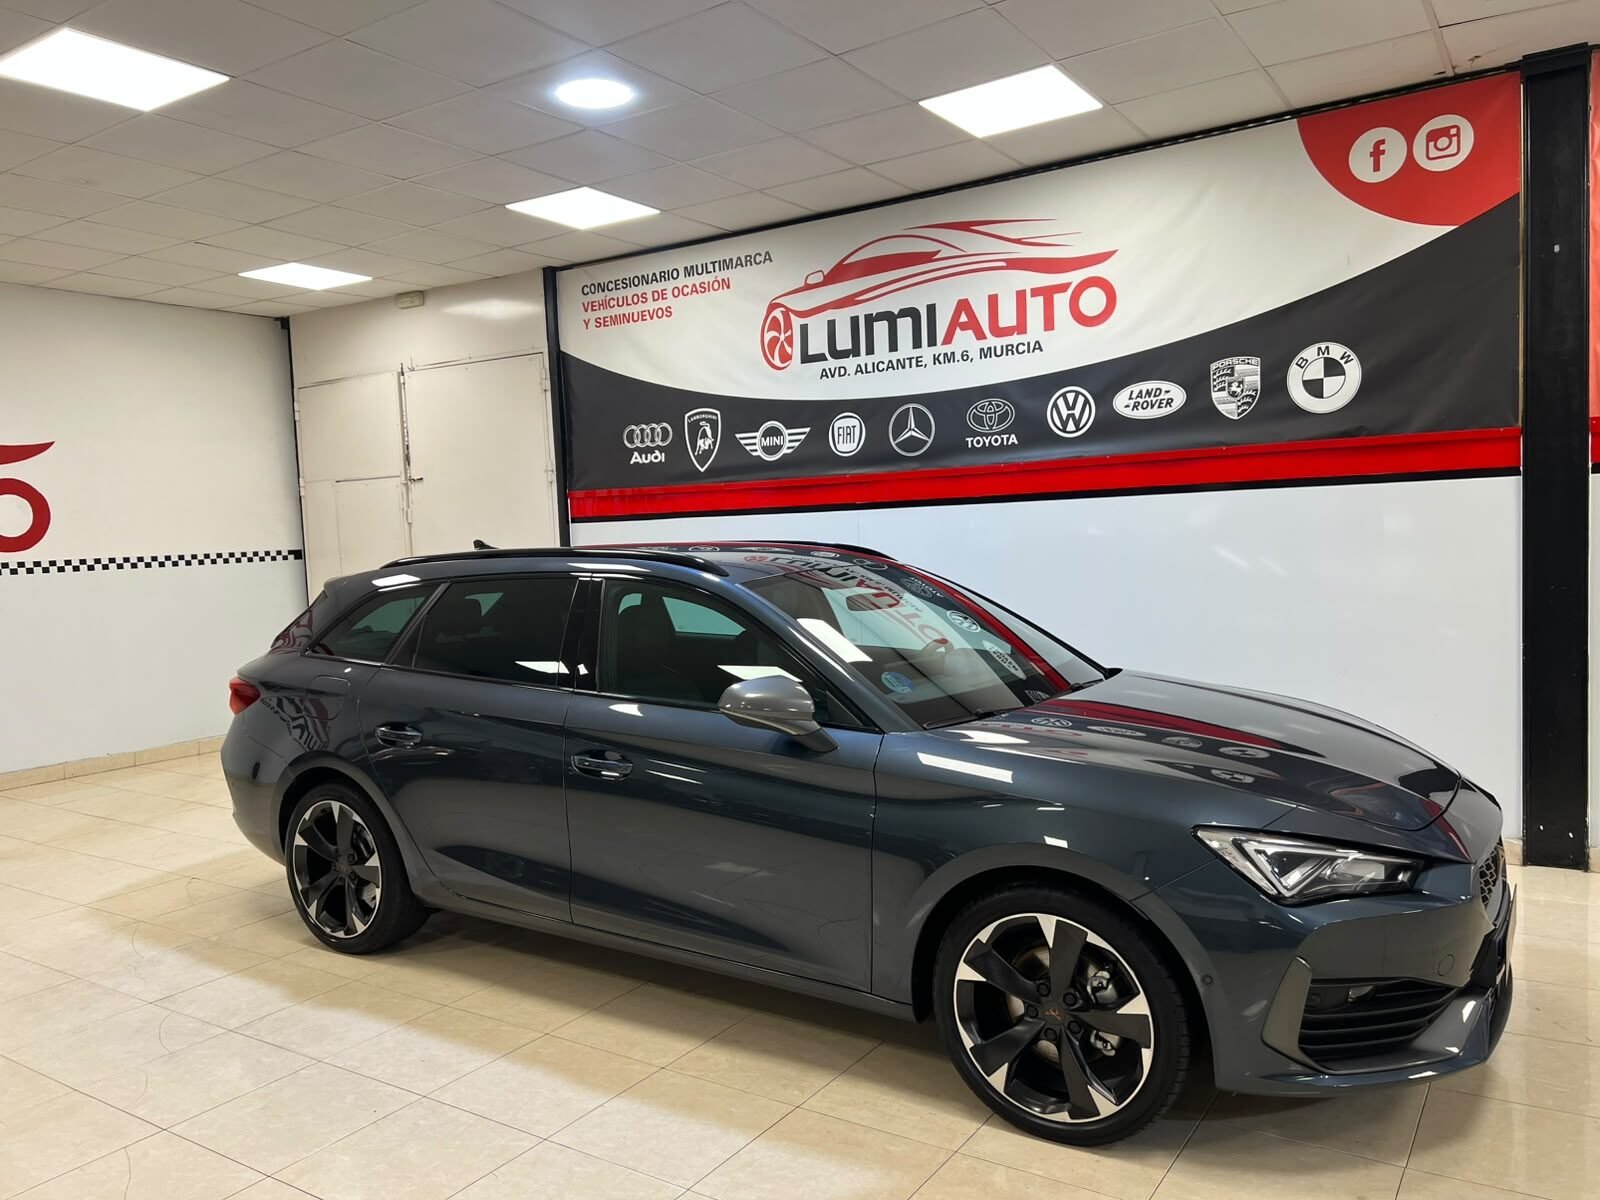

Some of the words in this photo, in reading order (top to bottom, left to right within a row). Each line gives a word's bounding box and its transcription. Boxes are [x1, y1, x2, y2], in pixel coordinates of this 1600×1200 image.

[581, 268, 680, 296] CONCESIONARIO
[684, 250, 773, 279] MULTIMARCA
[582, 292, 648, 313] VEHÍCULOS
[652, 288, 668, 303] DE
[671, 276, 731, 299] OCASIÓN
[583, 318, 591, 330] Y
[594, 305, 673, 329] SEMINUEVOS
[819, 365, 851, 380] AVD.
[854, 356, 928, 376] ALICANTE,
[932, 349, 974, 366] KM.6,
[978, 339, 1043, 360] MURCIA
[1212, 358, 1259, 370] PORSCHE
[1295, 345, 1354, 370] BMW
[761, 436, 783, 447] MINI
[837, 425, 857, 445] FIAT
[965, 433, 1018, 449] TOYOTA
[630, 450, 666, 465] Audi
